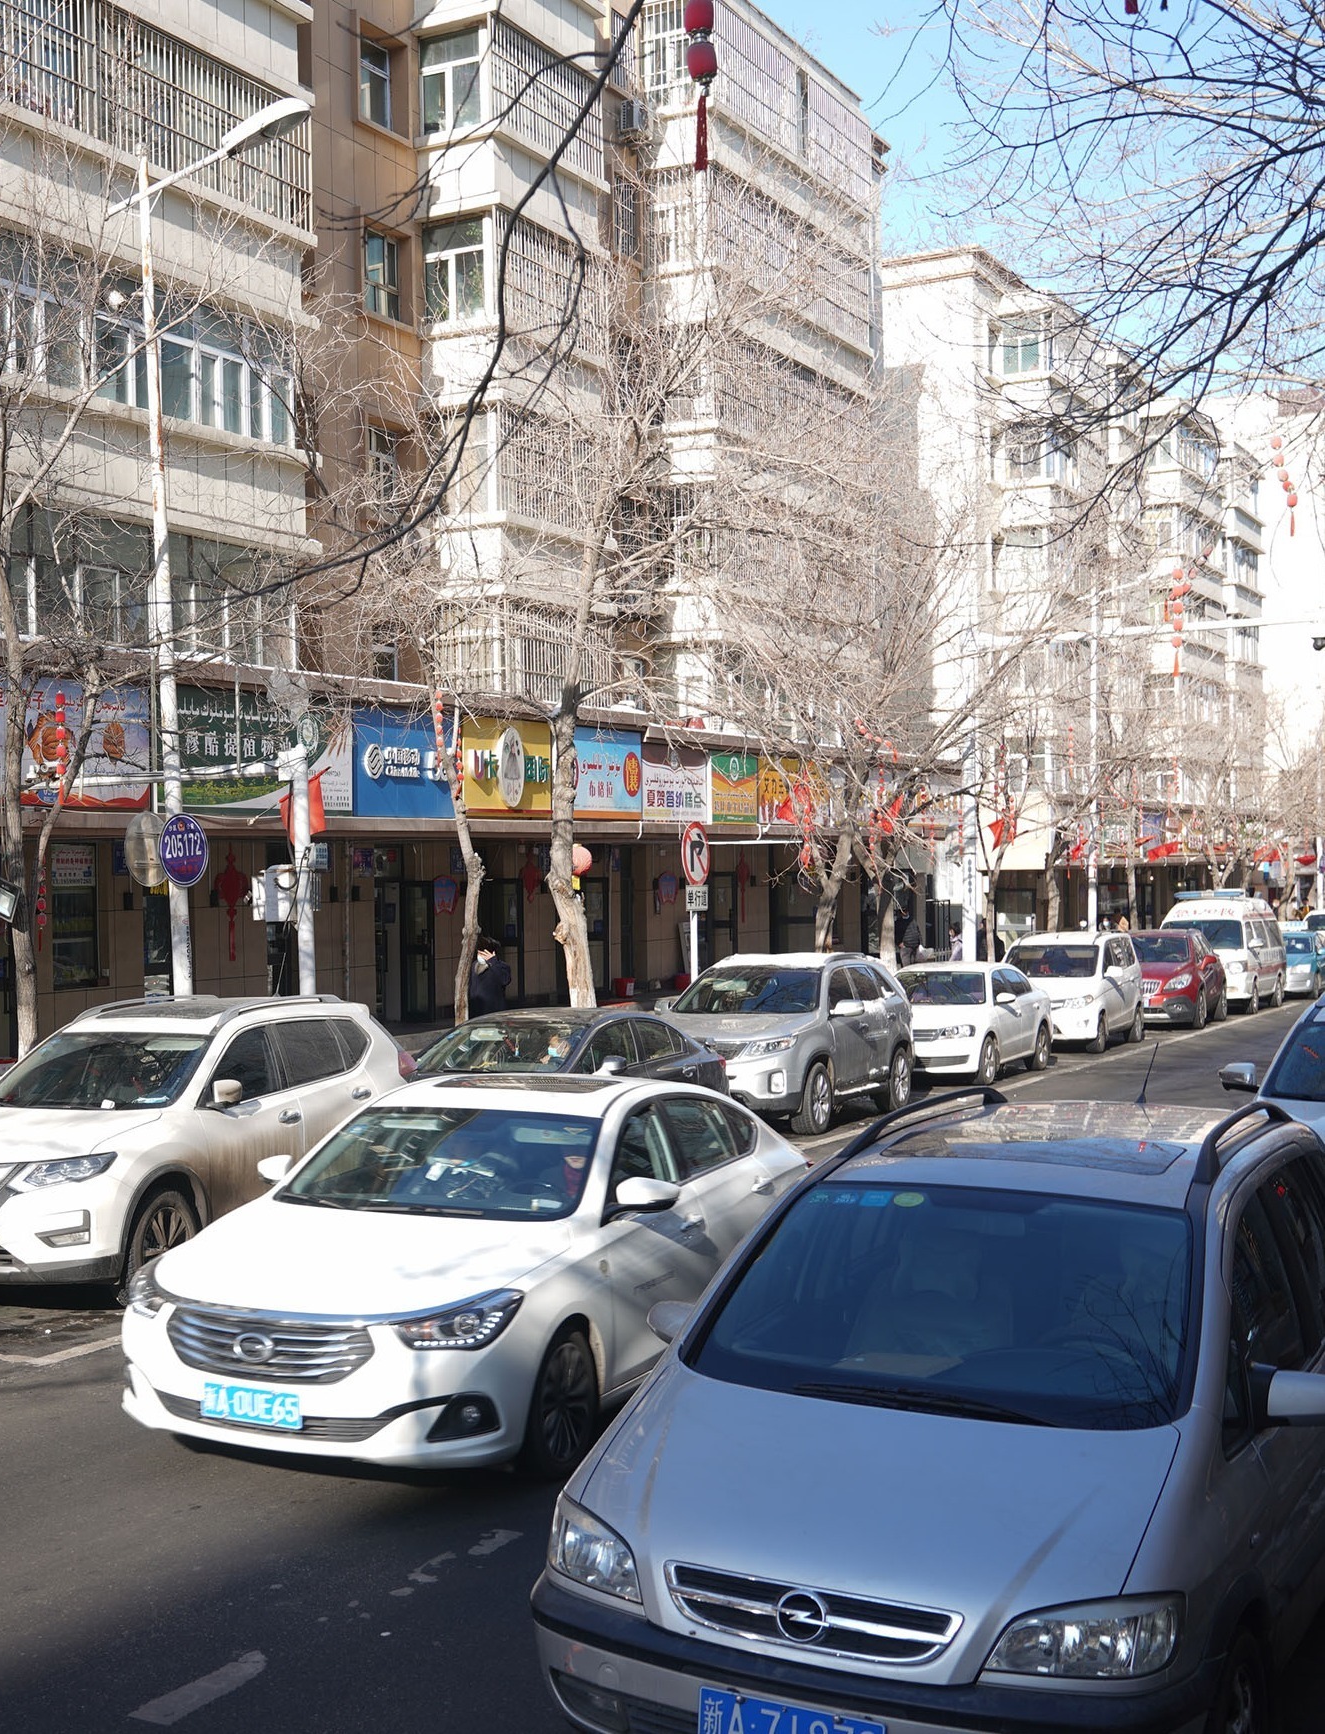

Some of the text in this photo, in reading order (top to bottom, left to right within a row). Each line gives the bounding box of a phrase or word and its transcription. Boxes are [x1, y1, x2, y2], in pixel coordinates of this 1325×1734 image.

[384, 747, 421, 765] 中国移动
[525, 755, 550, 783] 国际
[164, 831, 202, 859] 205172
[702, 1697, 875, 1734] 新A·71
